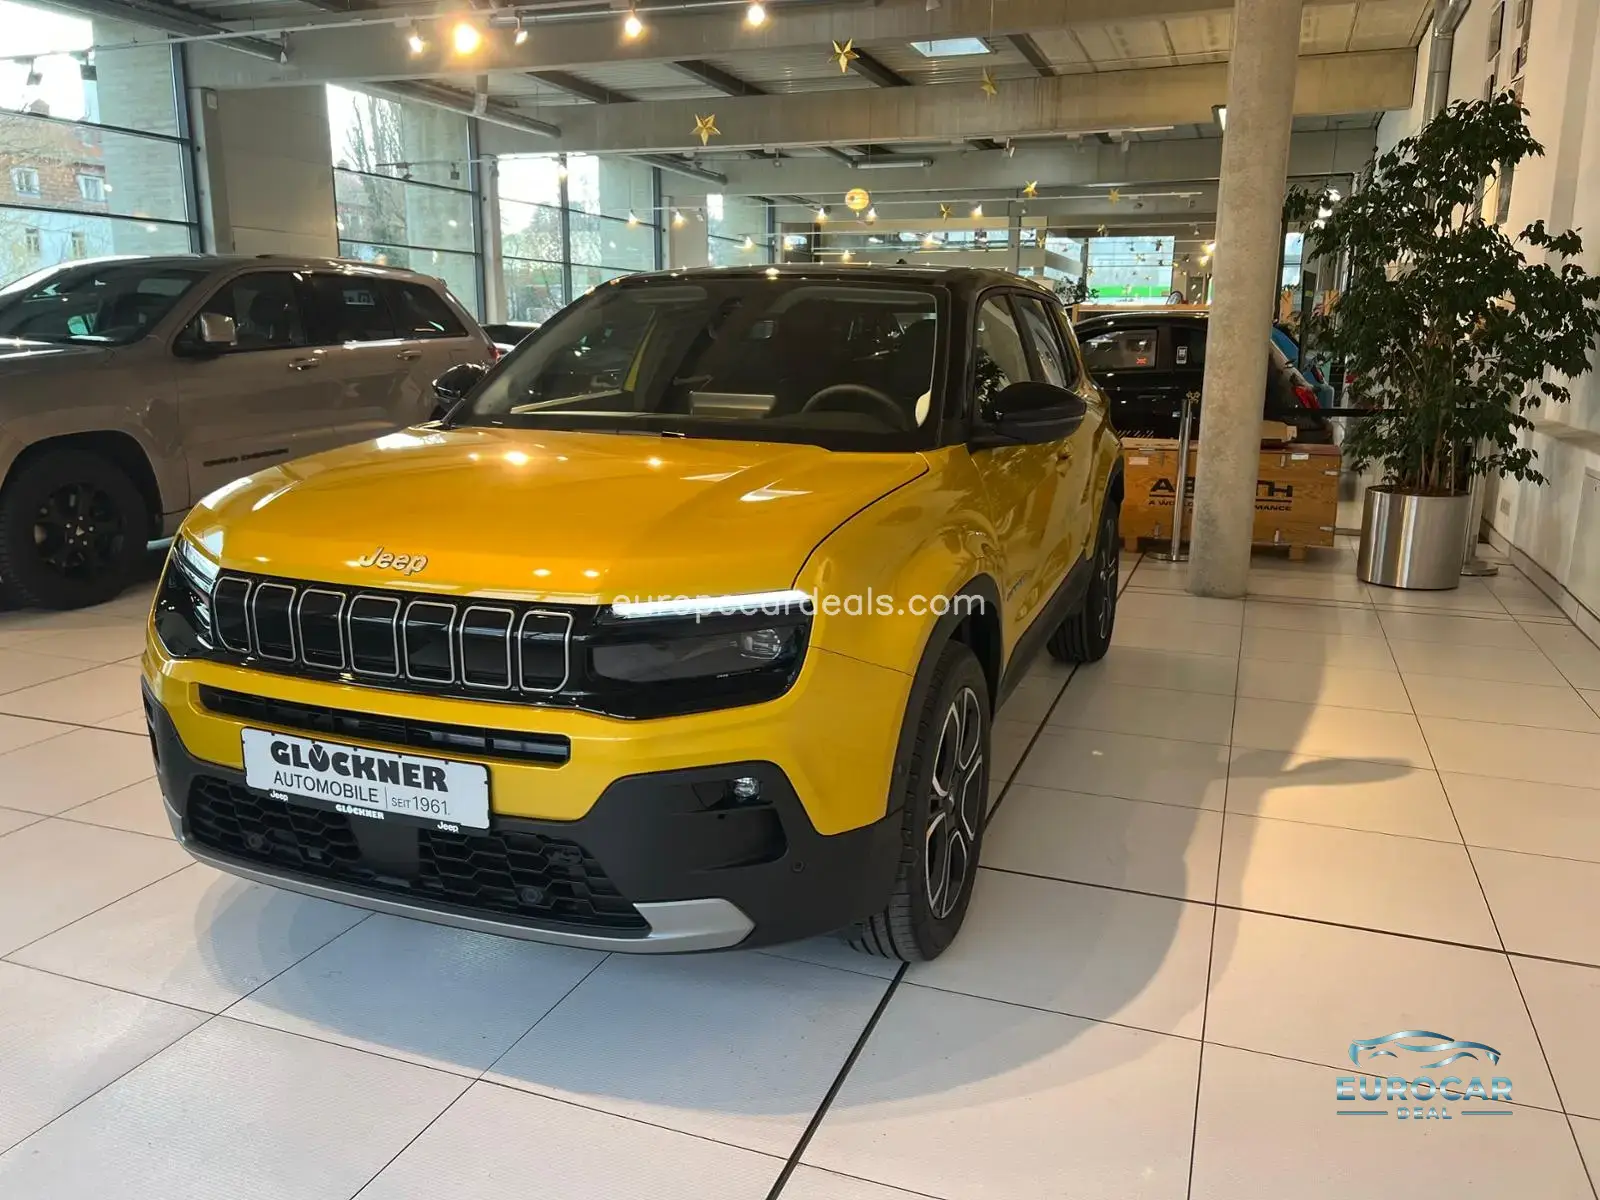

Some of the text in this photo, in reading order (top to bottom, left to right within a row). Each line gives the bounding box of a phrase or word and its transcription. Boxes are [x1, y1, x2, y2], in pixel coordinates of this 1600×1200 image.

[359, 545, 428, 576] Jeep
[270, 789, 289, 802] Jeep
[273, 770, 380, 804] AUTOMOBILE
[391, 796, 411, 809] SEIT
[437, 821, 459, 834] Jeep
